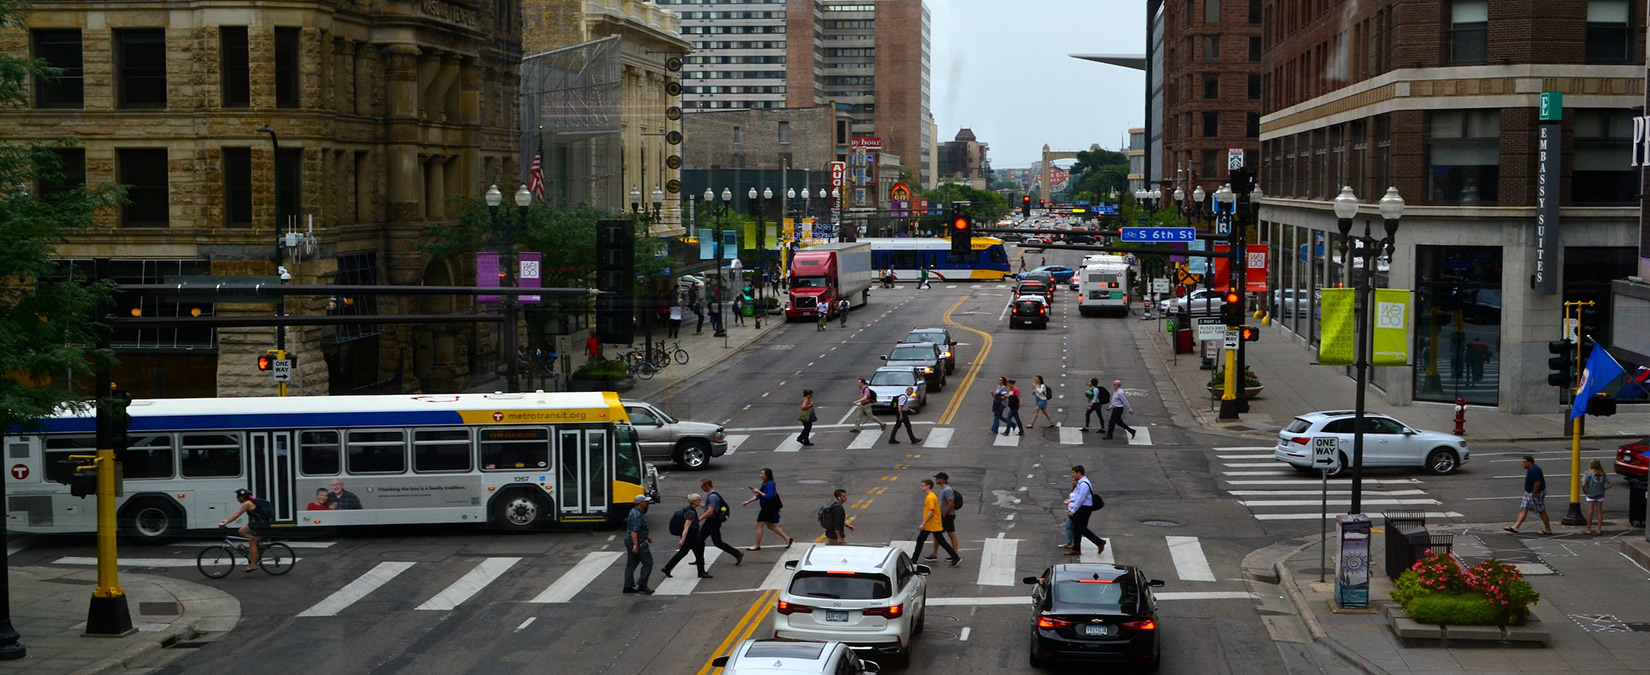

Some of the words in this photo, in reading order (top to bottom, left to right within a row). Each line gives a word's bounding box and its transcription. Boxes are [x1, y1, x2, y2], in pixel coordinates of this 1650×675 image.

[1539, 128, 1547, 208] EMBASSY
[1139, 230, 1147, 239] S
[1152, 230, 1174, 239] 6th
[1179, 230, 1193, 239] St
[1537, 214, 1545, 282] SUITES
[1381, 315, 1401, 326] DO
[508, 412, 586, 420] metrotransit.org
[1316, 439, 1335, 447] ONE
[13, 467, 27, 478] T
